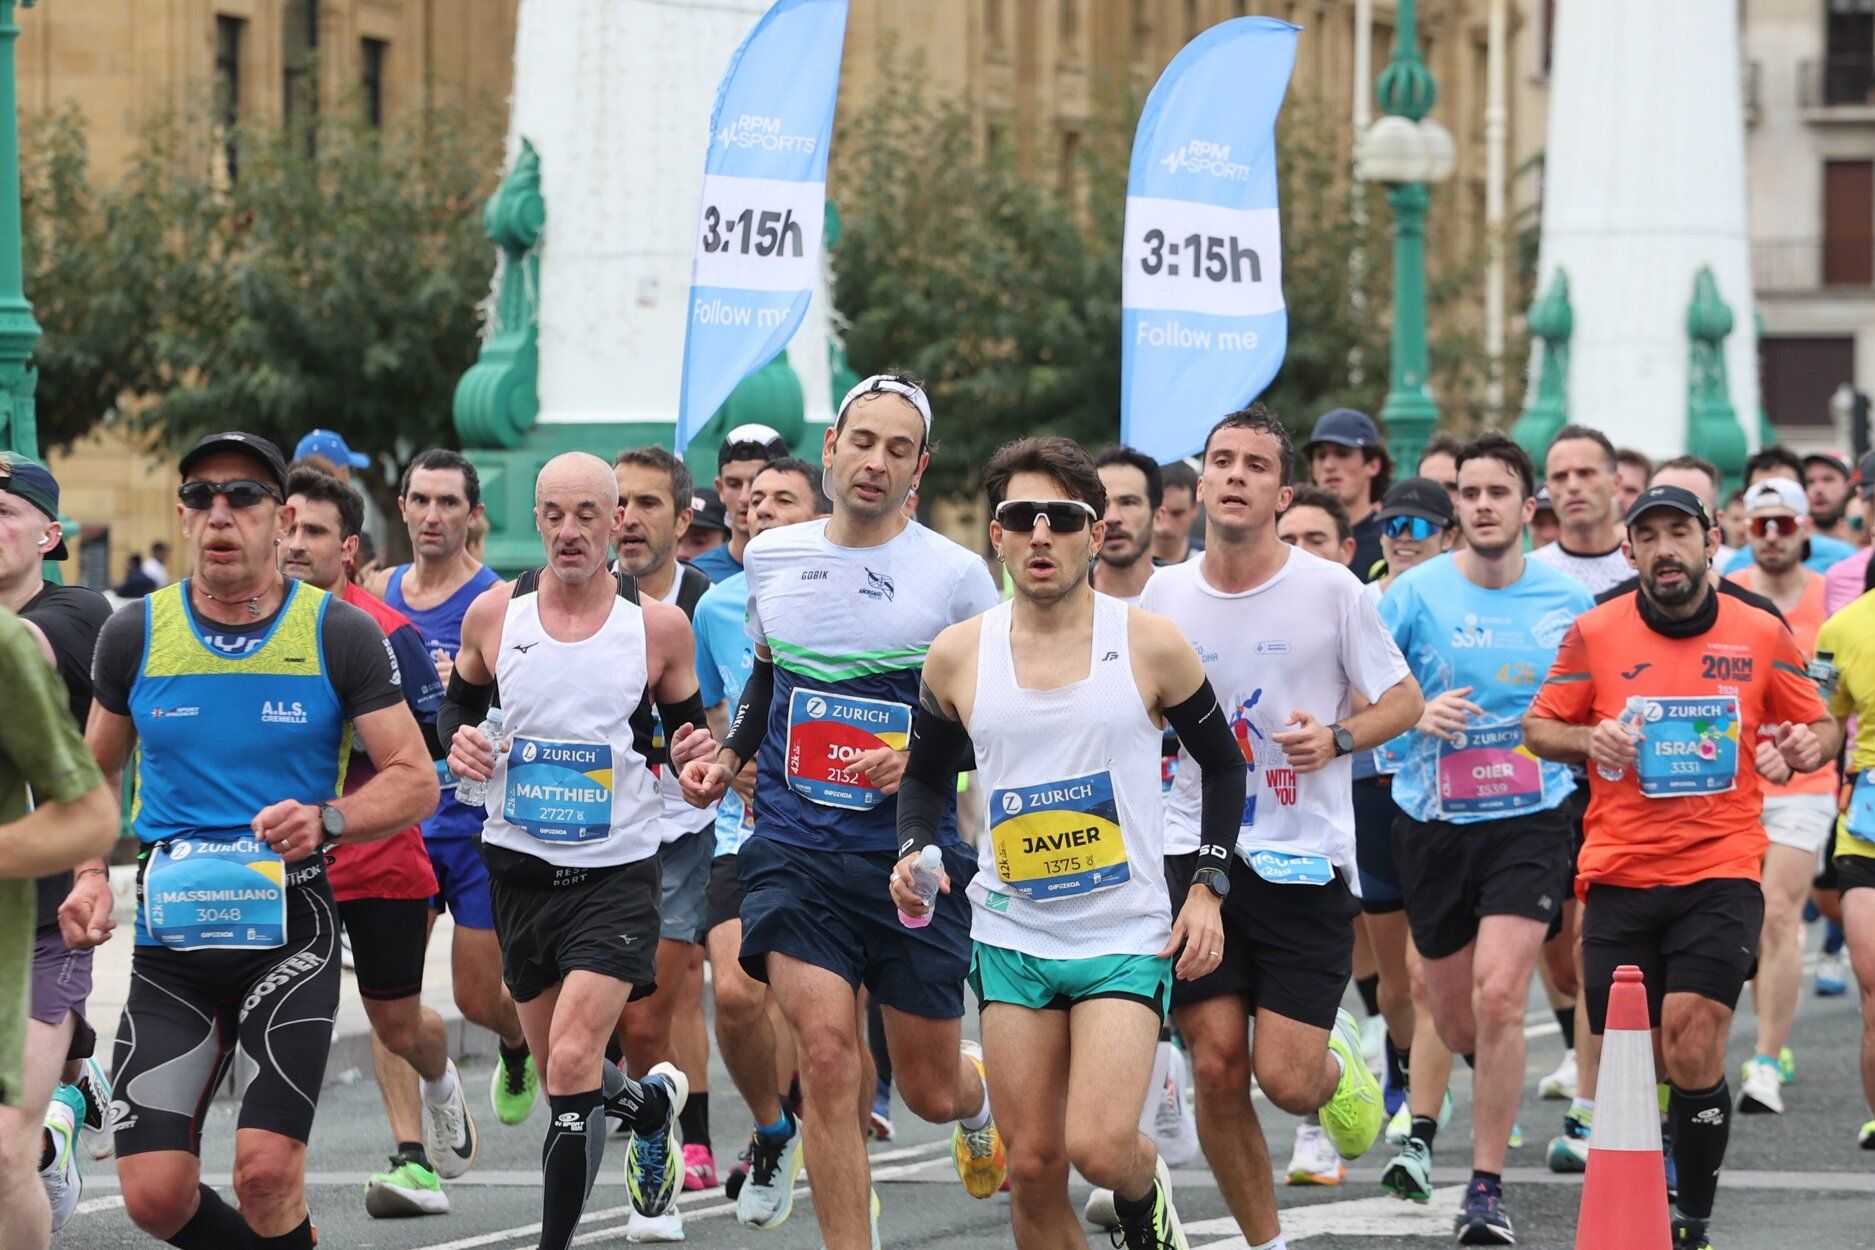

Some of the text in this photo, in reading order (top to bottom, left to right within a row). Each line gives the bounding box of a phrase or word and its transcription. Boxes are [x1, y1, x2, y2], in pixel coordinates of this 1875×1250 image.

[738, 114, 781, 134] RPM
[737, 132, 817, 154] SPORTS
[1188, 140, 1230, 161] RPM
[1186, 156, 1251, 182] SPORTS
[703, 205, 803, 258] 3:15h
[1141, 228, 1262, 283] 3:15h
[692, 299, 752, 327] Follow
[1136, 320, 1259, 351] Follow me
[801, 570, 829, 580] GOBIK
[1702, 655, 1753, 681] 20 KM
[262, 701, 307, 715] A.L.S.
[832, 705, 890, 724] ZURICH
[1668, 705, 1721, 717] ZURICH
[261, 715, 307, 724] CREMELLA
[1472, 730, 1520, 746] ZURICH
[542, 748, 596, 763] ZURICH
[790, 756, 800, 774] 42k
[1472, 763, 1514, 780] OIER
[1670, 761, 1700, 774] 3331
[1266, 769, 1296, 787] WITH
[516, 783, 609, 803] MATTHIEU
[1029, 784, 1092, 807] ZURICH
[1274, 788, 1296, 805] YOU
[539, 807, 574, 821] 2727
[196, 839, 260, 854] ZURICH
[1022, 826, 1101, 854] JAVIER
[1000, 858, 1011, 879] 42k
[1043, 857, 1081, 875] 1375
[553, 873, 588, 887] PORT
[162, 888, 279, 903] MASSIMILIANO
[152, 904, 165, 926] 42k
[196, 907, 242, 922] 3048
